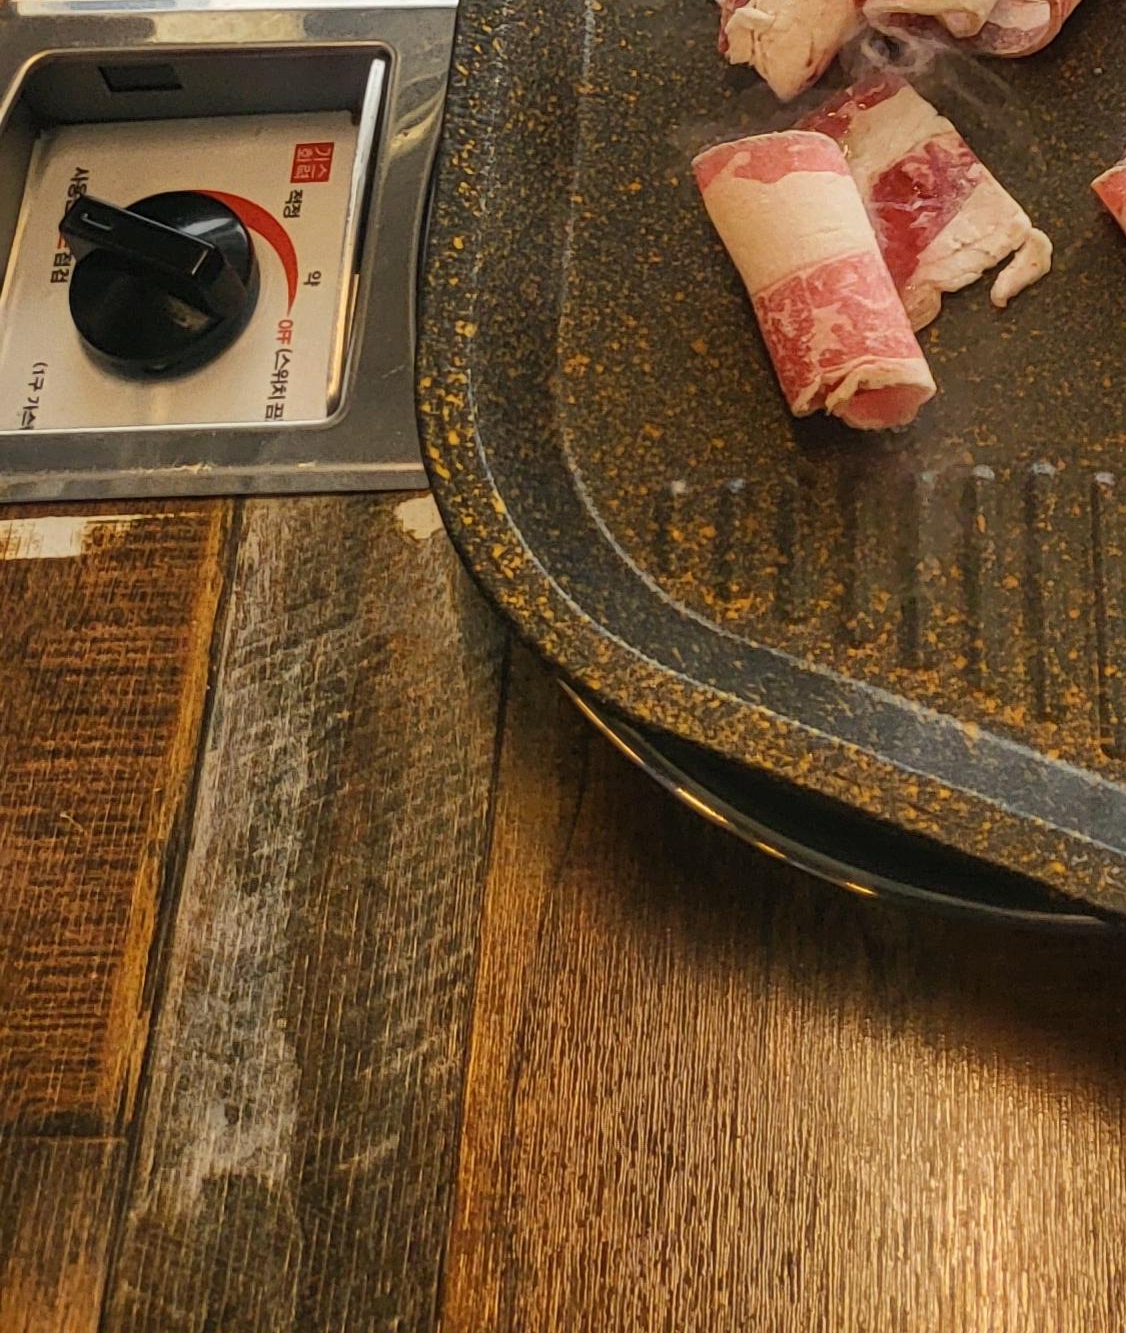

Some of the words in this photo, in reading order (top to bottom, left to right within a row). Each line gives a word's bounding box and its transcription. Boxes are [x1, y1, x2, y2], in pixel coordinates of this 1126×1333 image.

[282, 190, 303, 218] 적정
[50, 252, 72, 283] 점검
[303, 271, 321, 287] 약
[275, 320, 293, 345] OFF
[28, 362, 48, 391] (1구
[267, 348, 293, 400] (스위치
[19, 396, 39, 430] 가스
